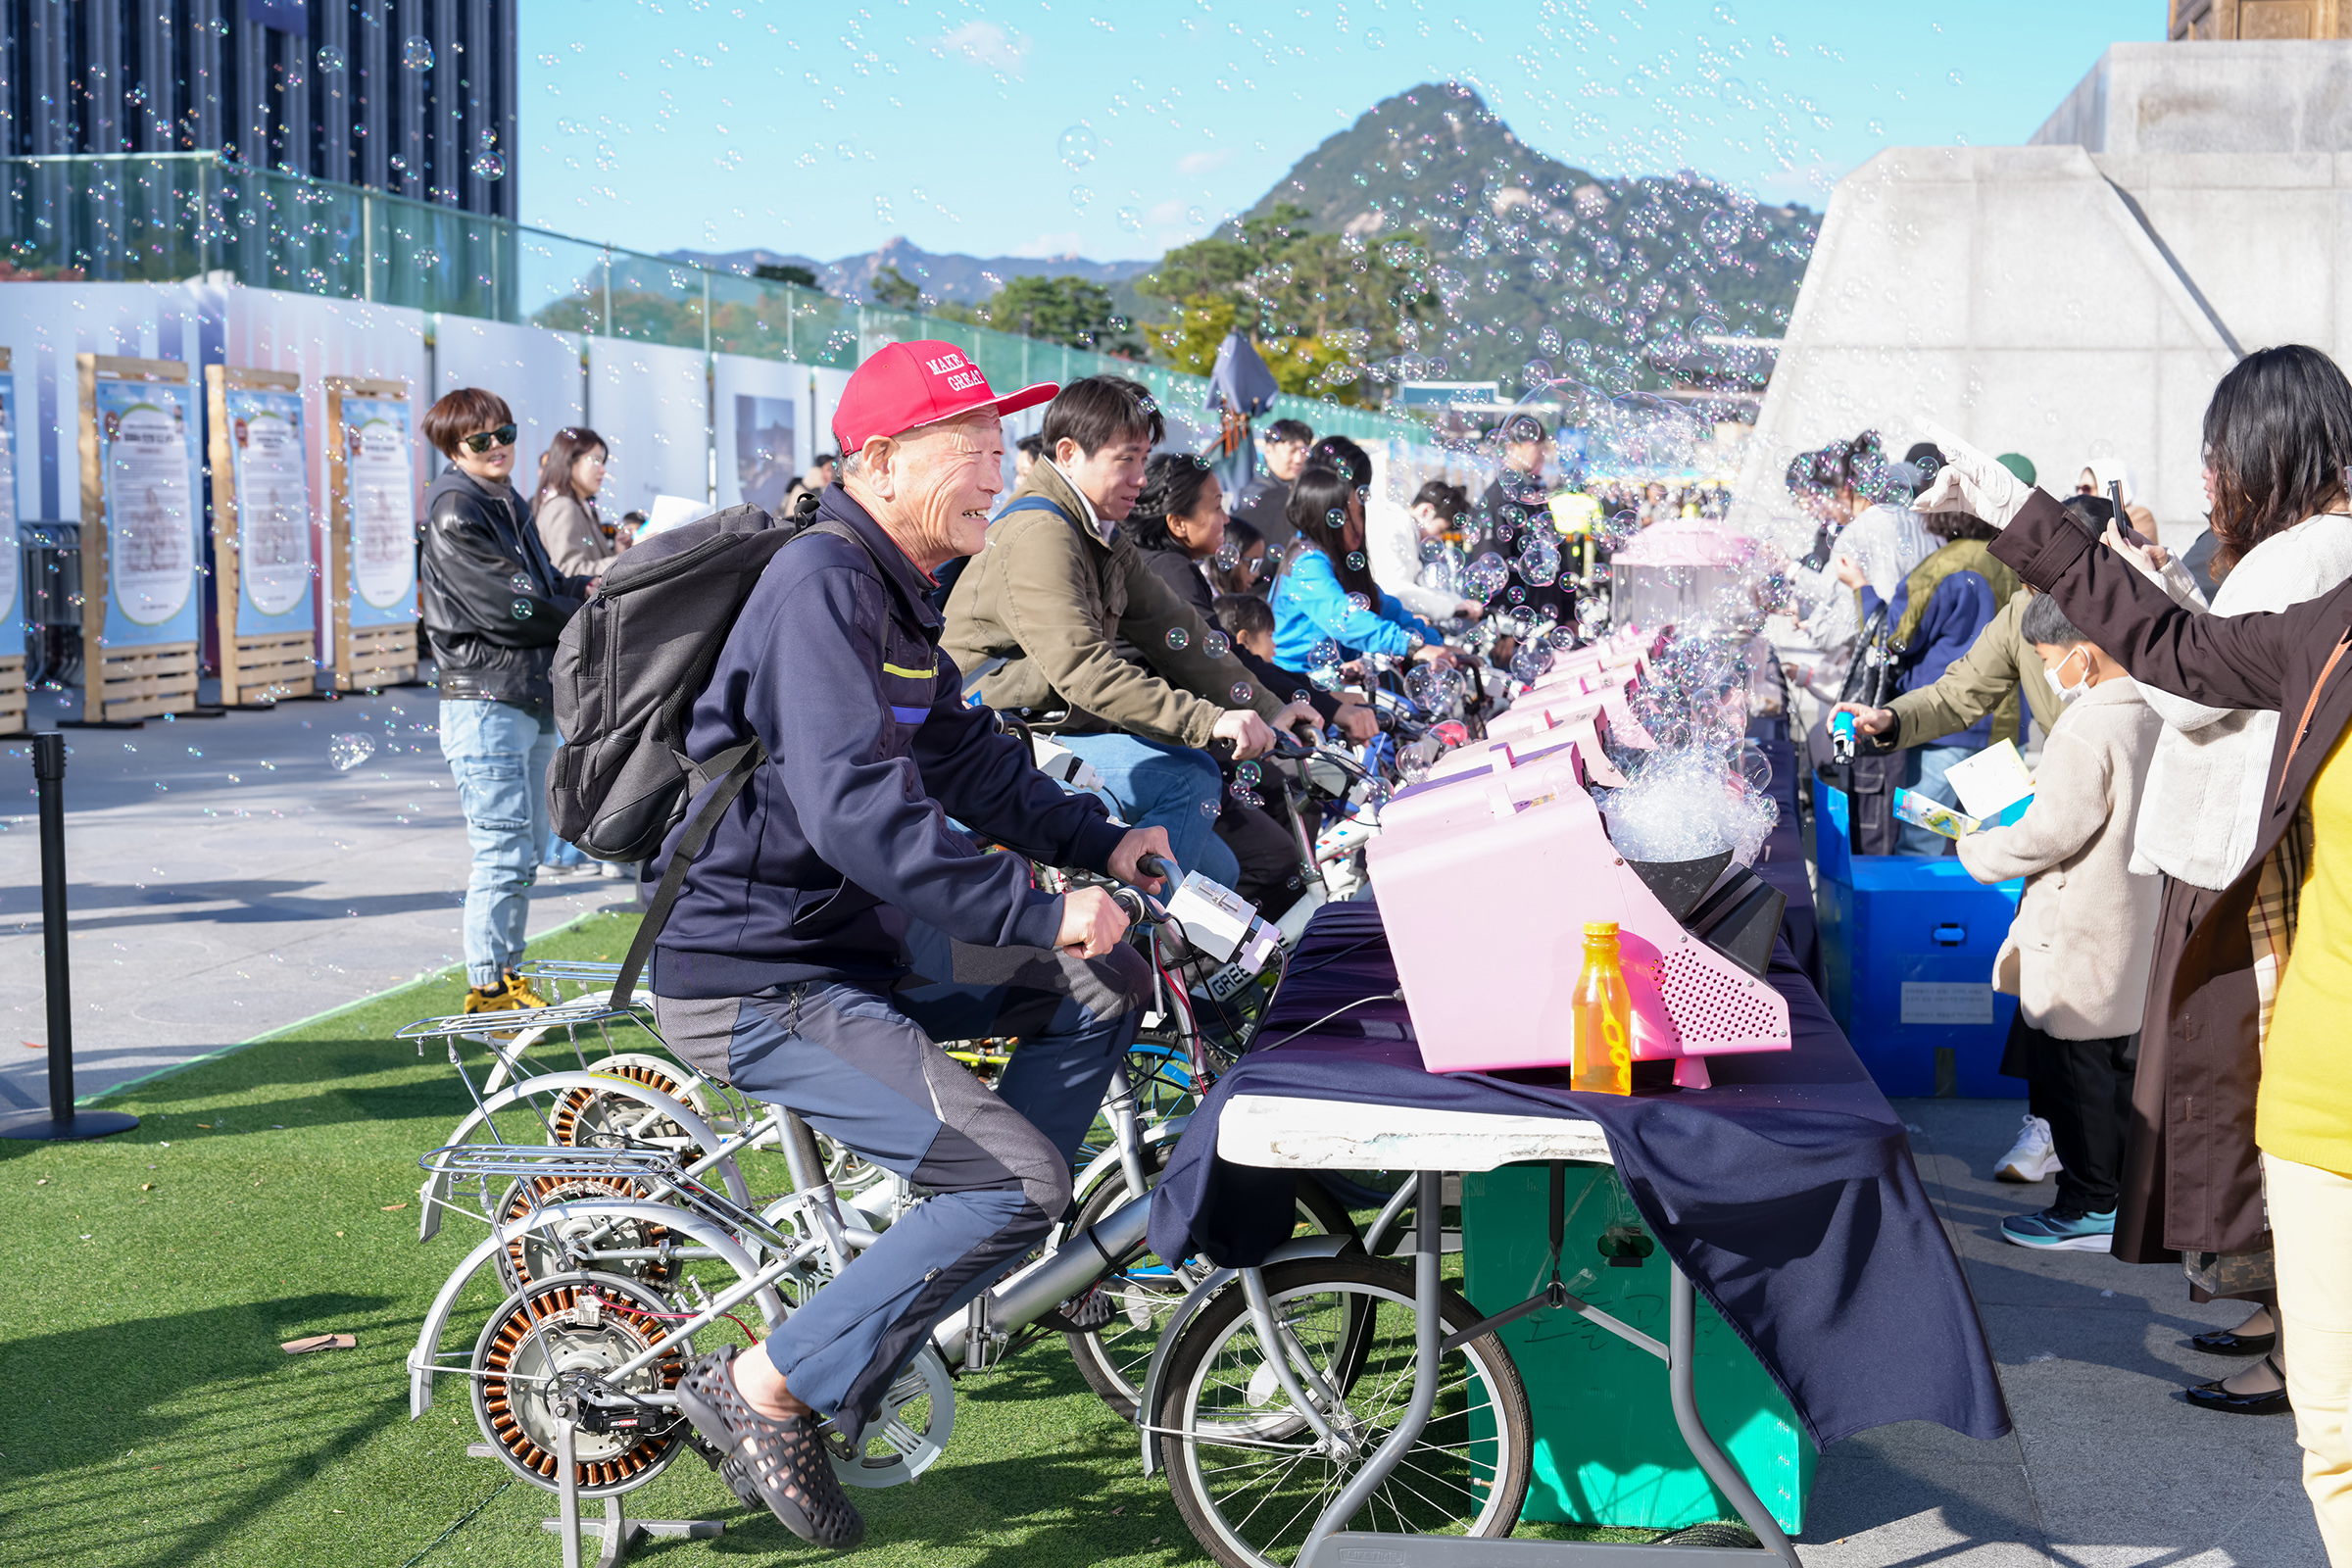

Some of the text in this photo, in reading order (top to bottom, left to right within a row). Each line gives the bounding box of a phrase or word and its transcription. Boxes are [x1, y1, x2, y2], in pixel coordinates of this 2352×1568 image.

[925, 353, 965, 375] MAKE
[947, 369, 985, 392] GREAT
[1211, 964, 1252, 997] GREE
[1348, 1550, 1397, 1563] LIFETIME
